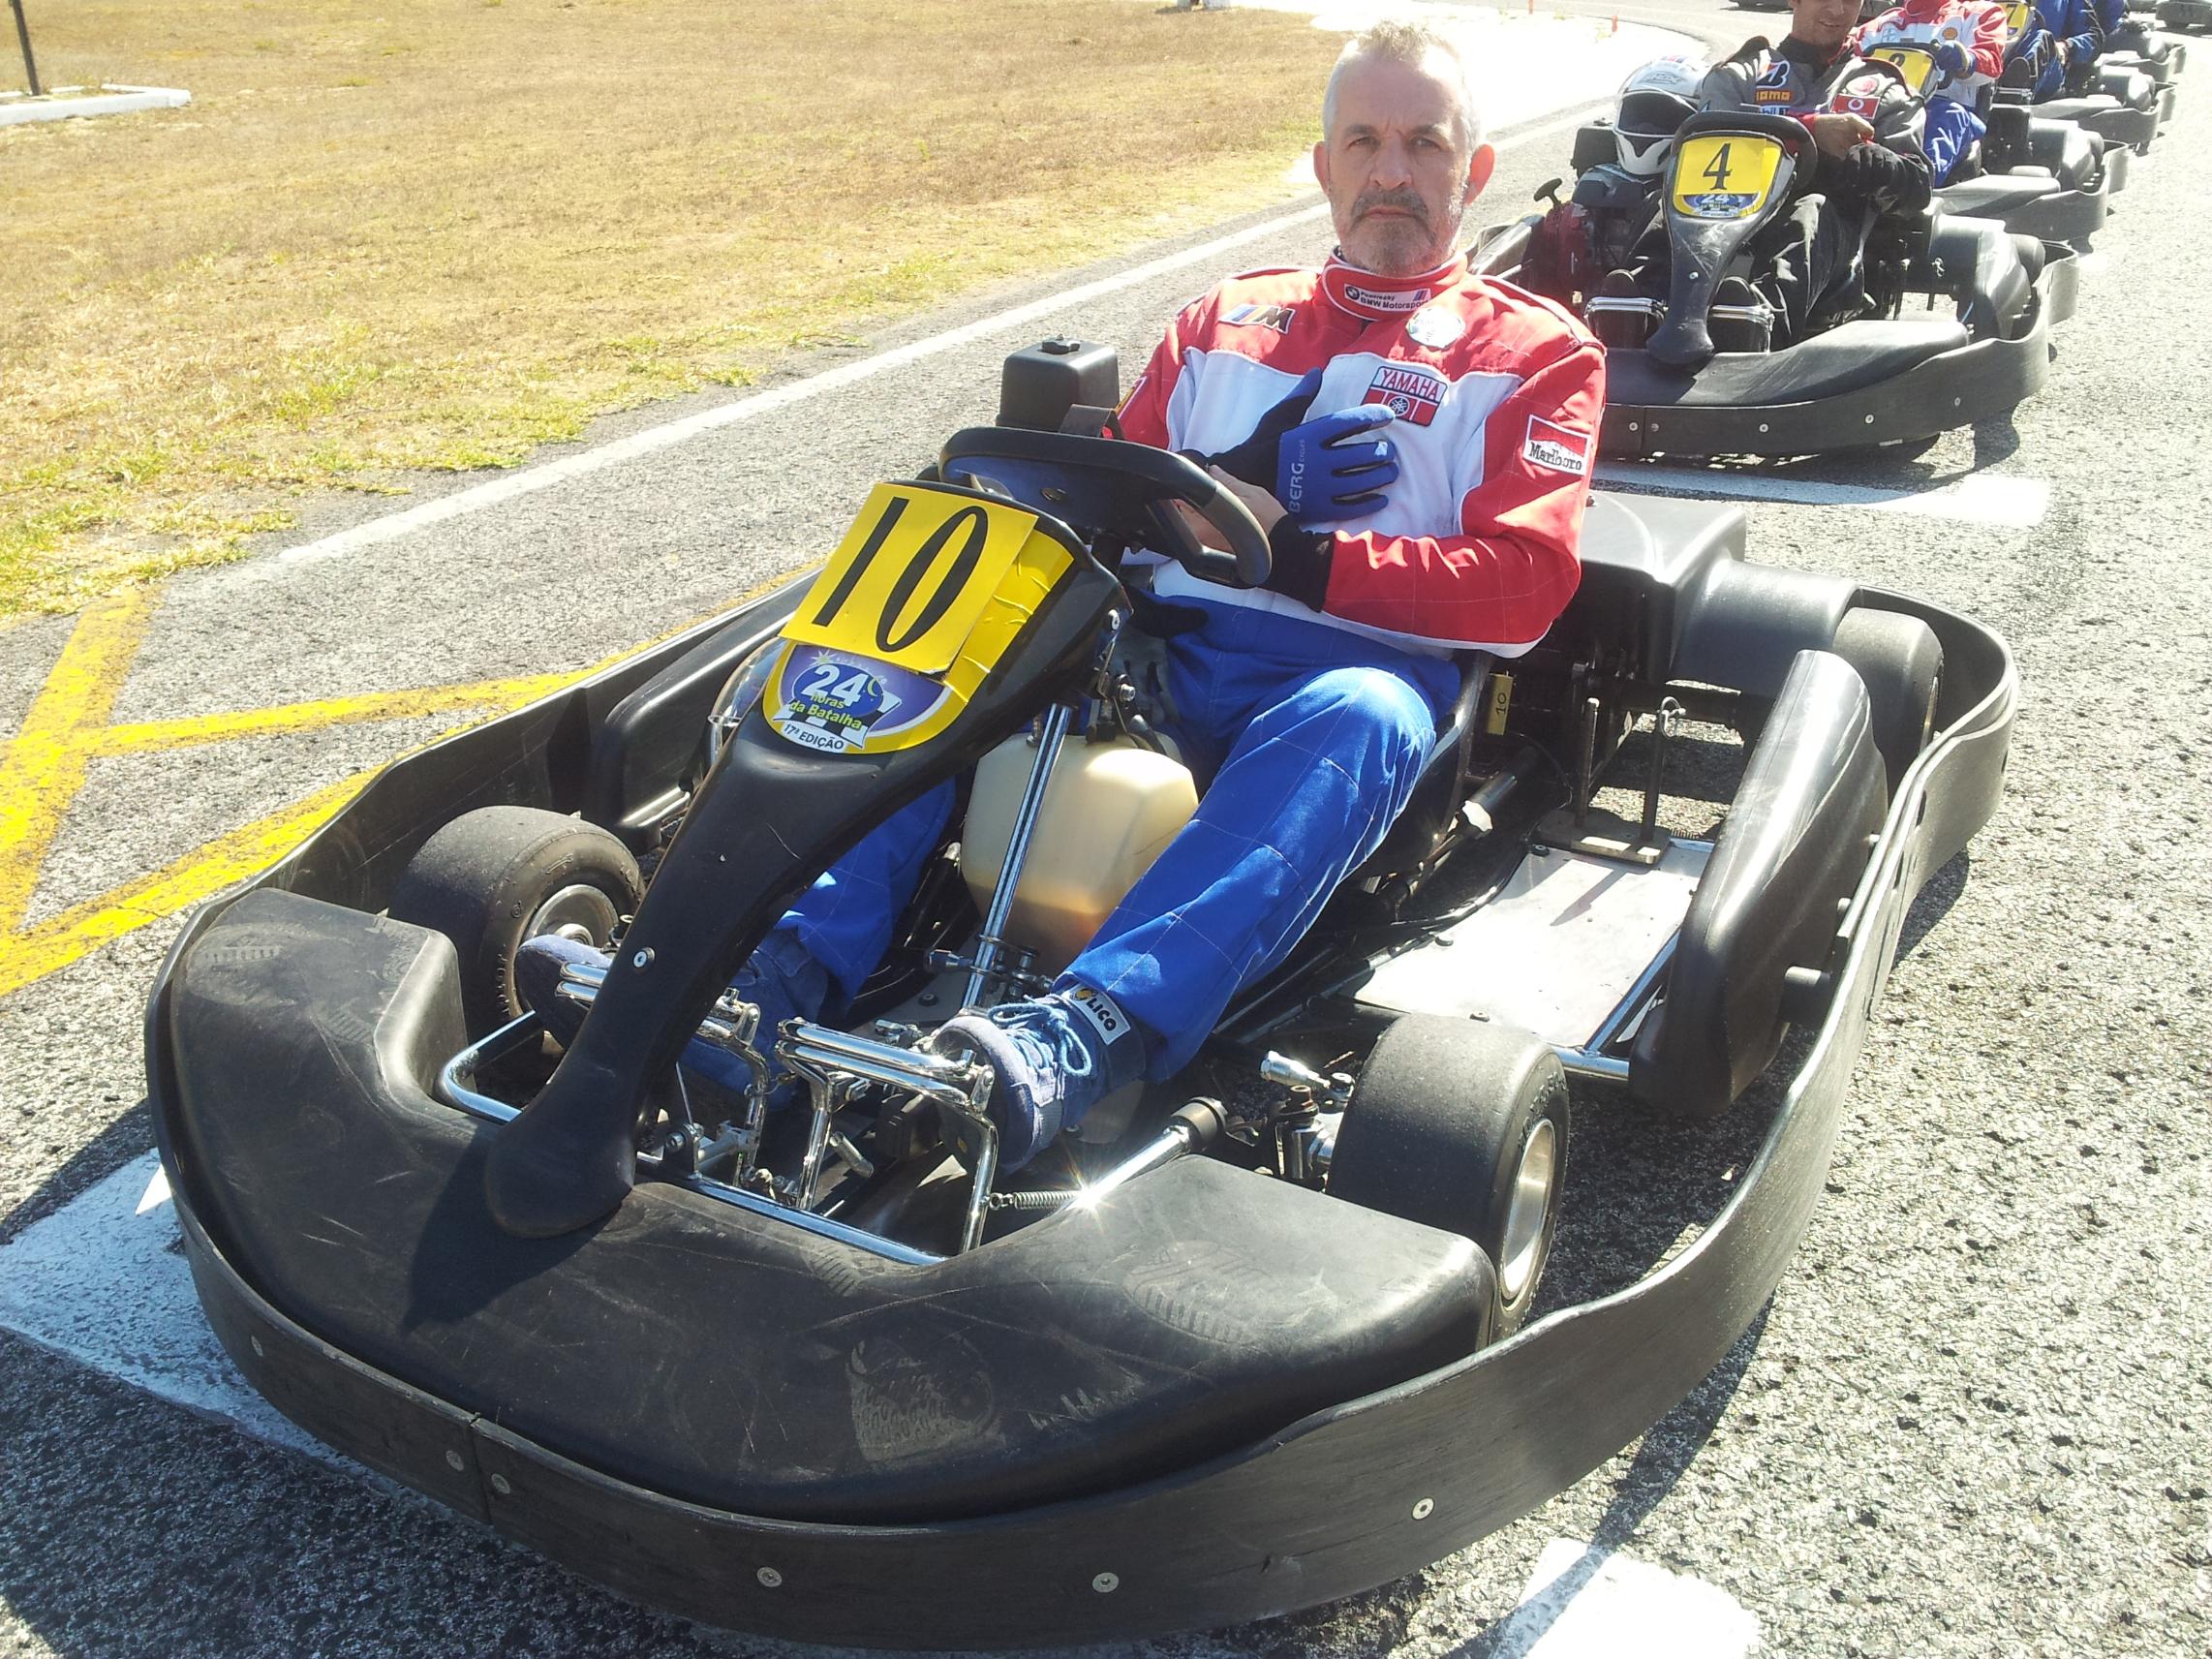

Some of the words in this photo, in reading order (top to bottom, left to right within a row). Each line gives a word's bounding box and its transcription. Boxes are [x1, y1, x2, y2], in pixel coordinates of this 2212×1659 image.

[1703, 142, 1733, 191] 4
[1361, 296, 1382, 307] BMW
[1381, 369, 1440, 401] YAMAHA
[1529, 442, 1582, 470] Marlboro
[812, 496, 989, 653] 10
[801, 664, 869, 707] 24
[810, 691, 845, 709] horas
[789, 700, 806, 713] da
[808, 704, 863, 730] Batalha
[1495, 692, 1507, 715] 10
[799, 731, 845, 751] EDIÇÃO
